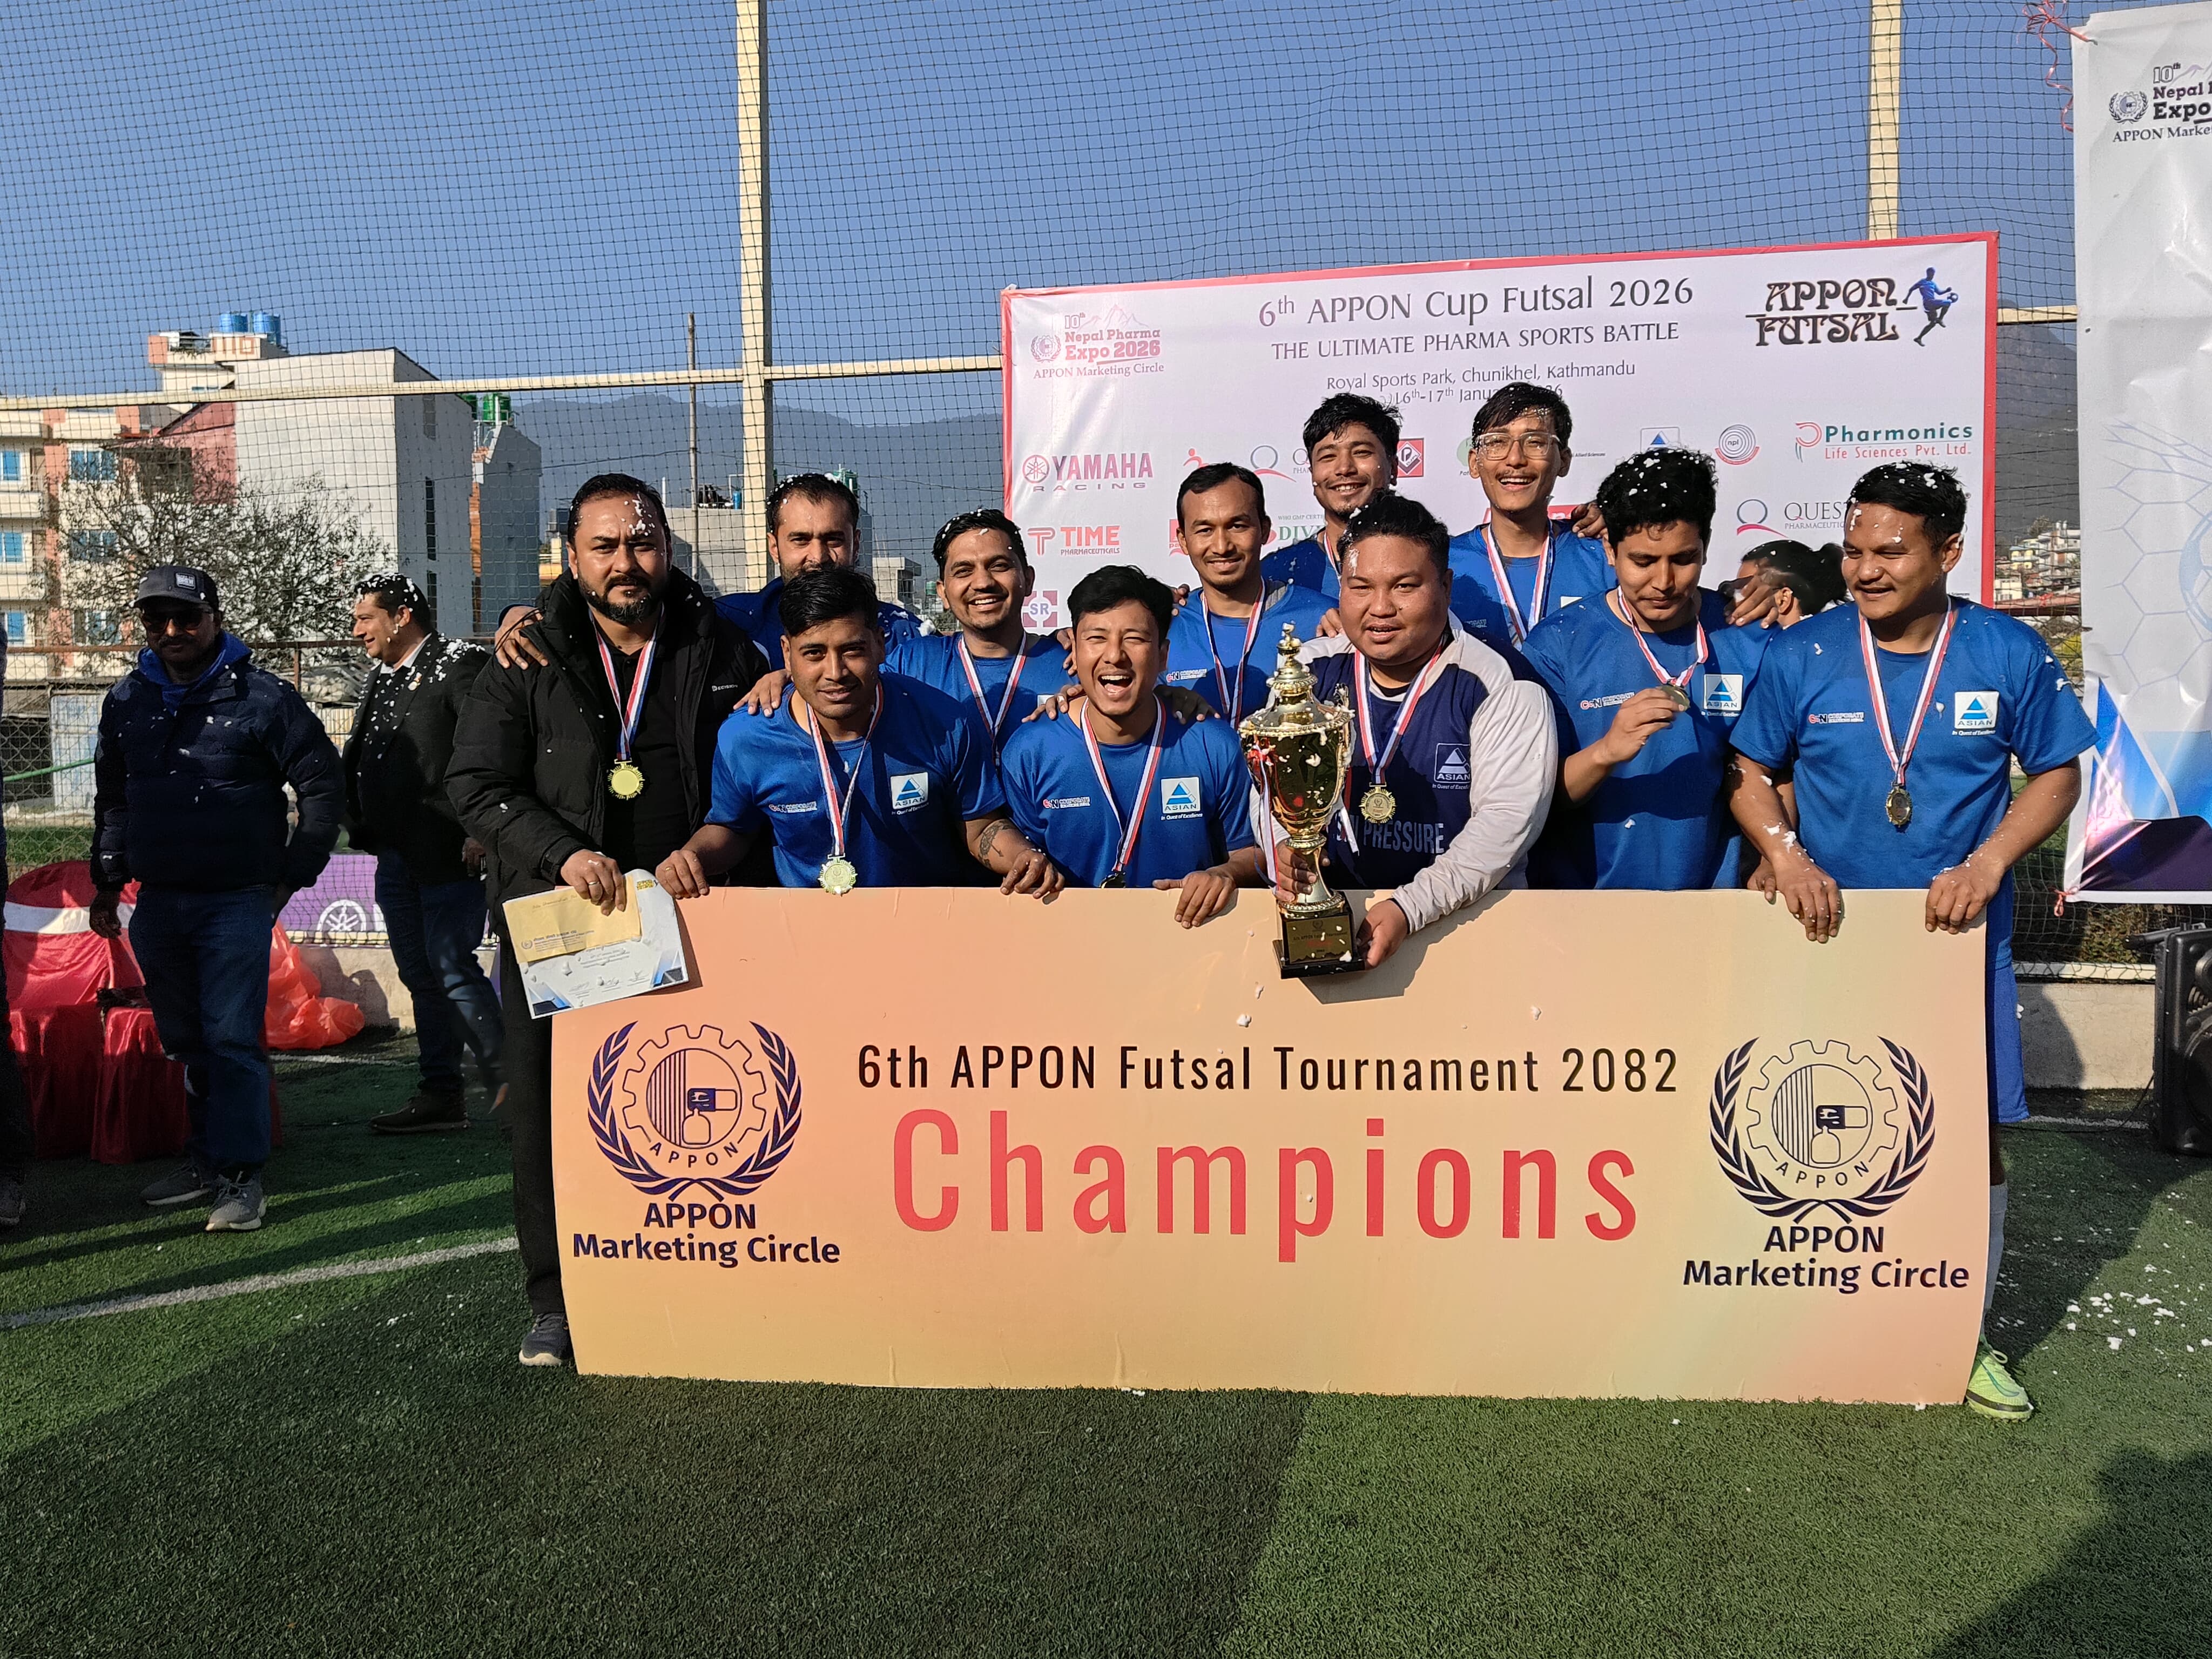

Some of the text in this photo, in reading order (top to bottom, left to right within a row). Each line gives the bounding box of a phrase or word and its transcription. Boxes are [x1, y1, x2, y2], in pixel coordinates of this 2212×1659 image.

[2153, 62, 2181, 84] 10th
[2153, 82, 2203, 100] Nepal
[2153, 101, 2211, 122] Expo
[2112, 125, 2212, 143] APPON Marke
[1259, 275, 1694, 327] 6th APPON Cup Futsal 2026
[1765, 278, 1898, 312] APPON
[1064, 312, 1086, 329] 10th
[1755, 312, 1900, 347] FUTSAL
[1064, 328, 1161, 344] Nepal Pharma
[1271, 322, 1680, 360] THE ULTIMATE PHARMA SPORTS BATTLE
[1065, 340, 1161, 363] Expo 2026
[1033, 362, 1164, 379] APPON Marketing Circle
[1327, 360, 1636, 391] Royal Sports Park, Chunikhel, Kathmandu
[1825, 422, 1973, 443] Pharmonics
[1825, 443, 1972, 460] Life Sciences Pvt. Ltd.
[1051, 453, 1154, 481] YAMAHA
[1033, 482, 1146, 492] RACING
[1060, 525, 1121, 547] TIME
[1060, 547, 1121, 556] PHARMACEUTICALS
[1029, 603, 1050, 615] SR
[894, 797, 925, 807] ASIAN
[1363, 820, 1445, 854] PRESSURE
[858, 1044, 1677, 1093] 6th APPON Futsal Tournament 2082
[649, 1141, 739, 1168] APPON
[893, 1109, 1637, 1263] Champions
[1775, 1161, 1870, 1189] APPON
[643, 1202, 756, 1230] APPON
[573, 1233, 841, 1269] Marketing Circle
[1763, 1225, 1884, 1253] APPON
[1683, 1257, 1970, 1294] Marketing Circle
